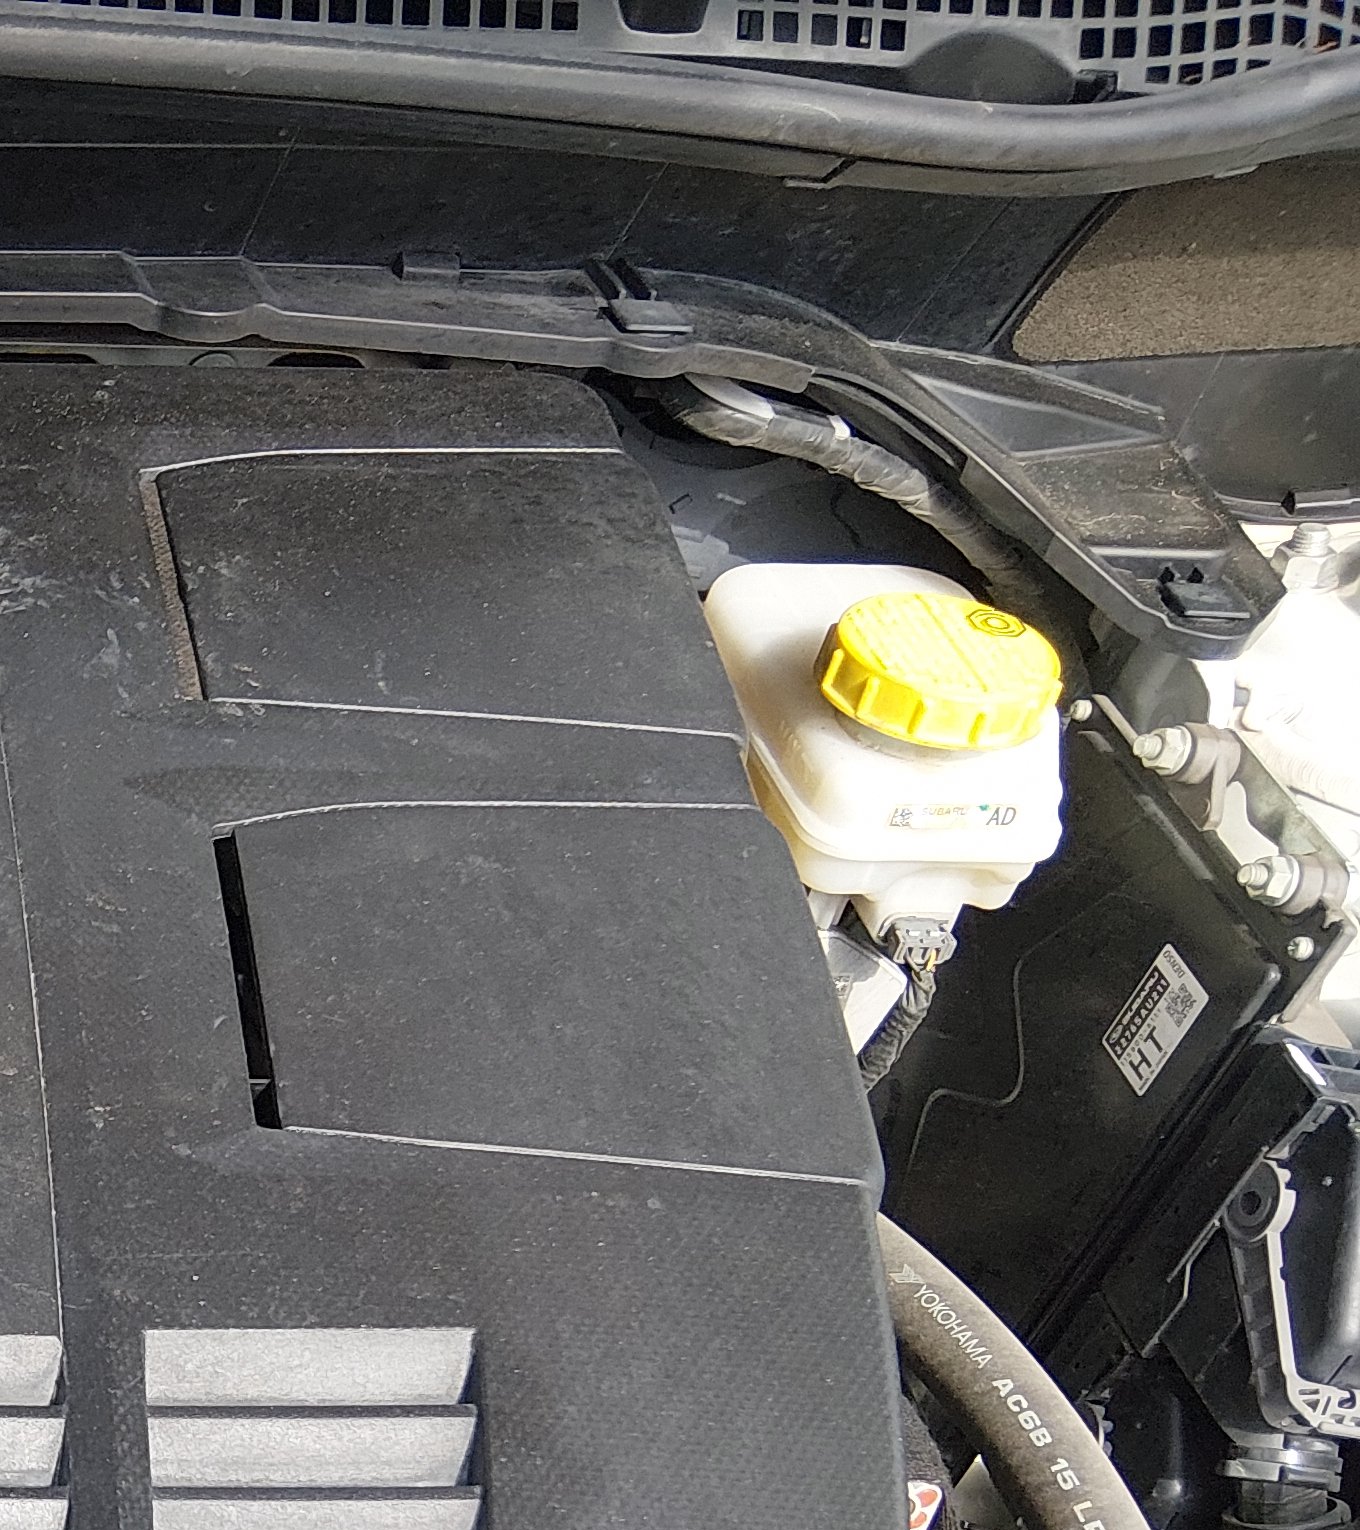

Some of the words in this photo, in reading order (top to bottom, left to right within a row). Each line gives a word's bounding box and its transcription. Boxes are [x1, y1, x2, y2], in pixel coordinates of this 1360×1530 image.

[985, 806, 1017, 826] AD
[1162, 950, 1186, 979] DENSO
[1120, 970, 1159, 1026] SUBARU
[913, 1284, 994, 1370] YOKOHAMA
[991, 1377, 1053, 1448] AC6B
[1049, 1456, 1081, 1492] 15
